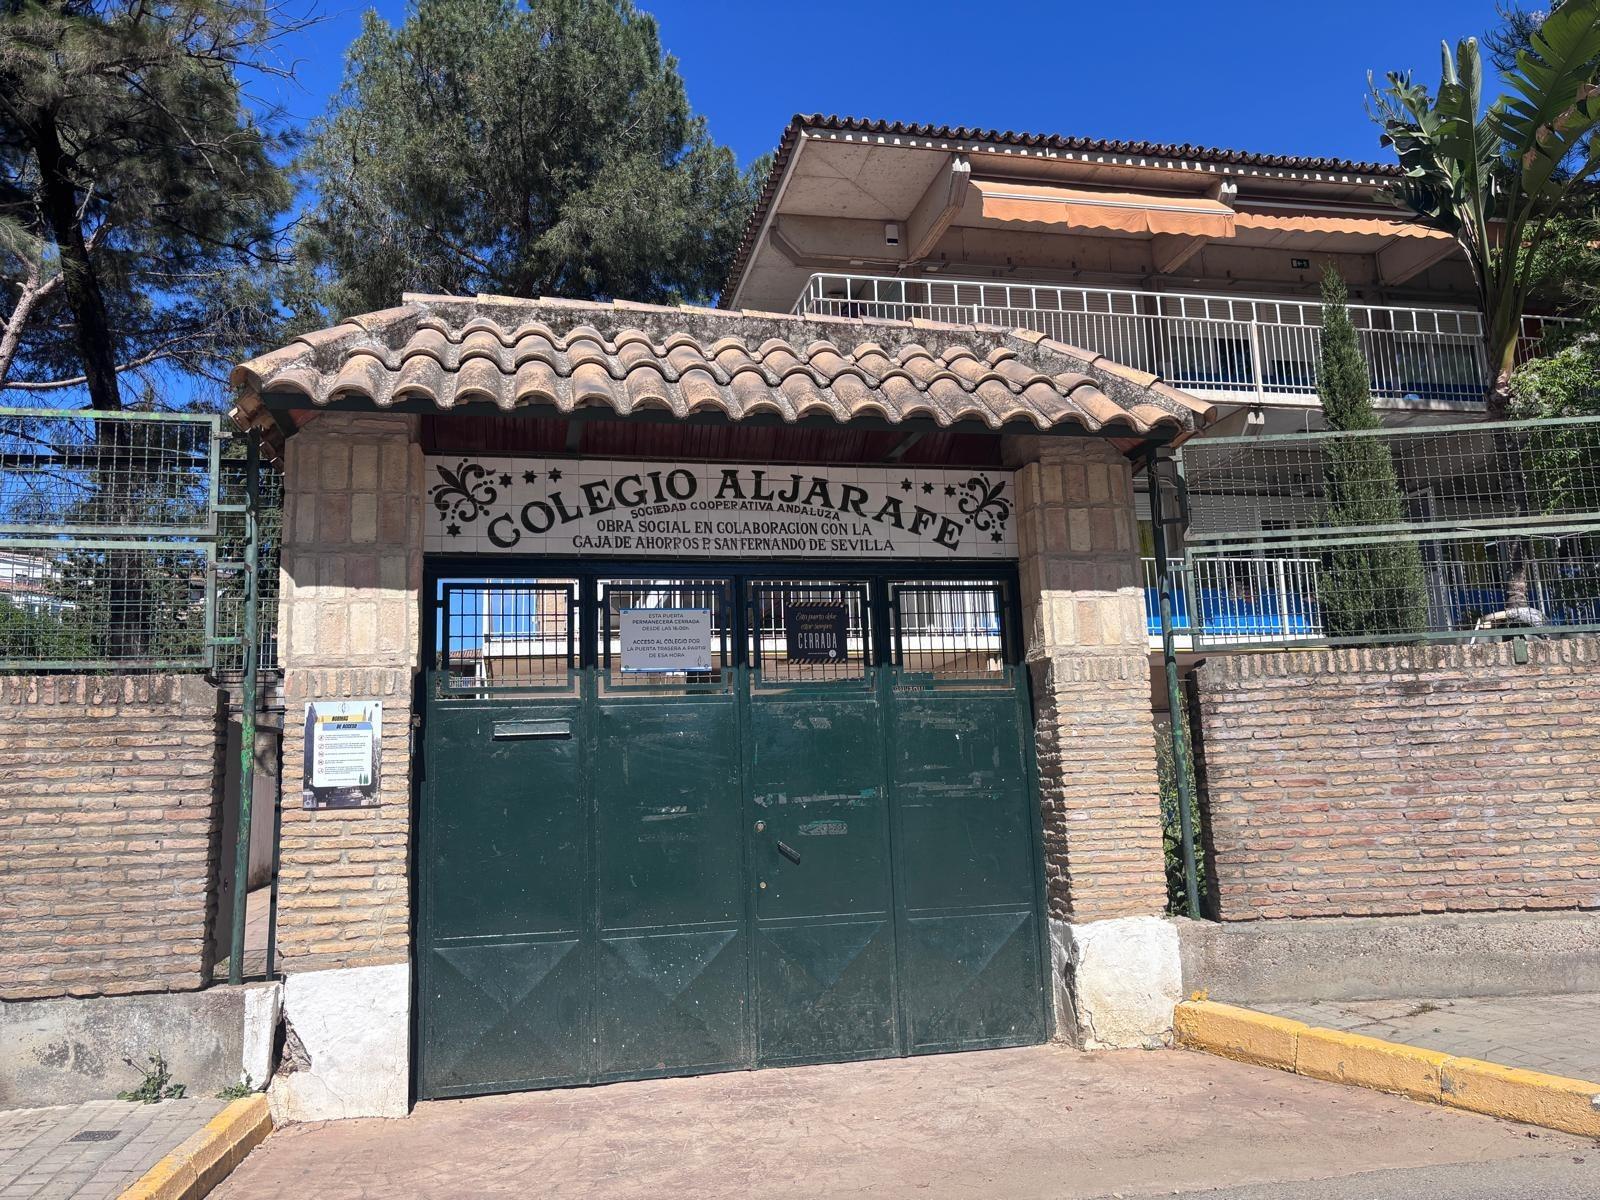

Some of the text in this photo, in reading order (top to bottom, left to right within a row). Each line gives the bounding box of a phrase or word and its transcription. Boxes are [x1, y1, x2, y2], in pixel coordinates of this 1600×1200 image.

[487, 468, 964, 551] COLEGIO ALJARAFE
[630, 500, 841, 521] SOCIEDAD COOPERATIVA ANDALUZA
[596, 519, 872, 536] OBRA SOCIAL EN COLABORACION CON LA
[572, 535, 895, 552] CAJA DE AHORROS P. SAN FERNANDO DE SEVILLA
[797, 632, 838, 649] CERRADA
